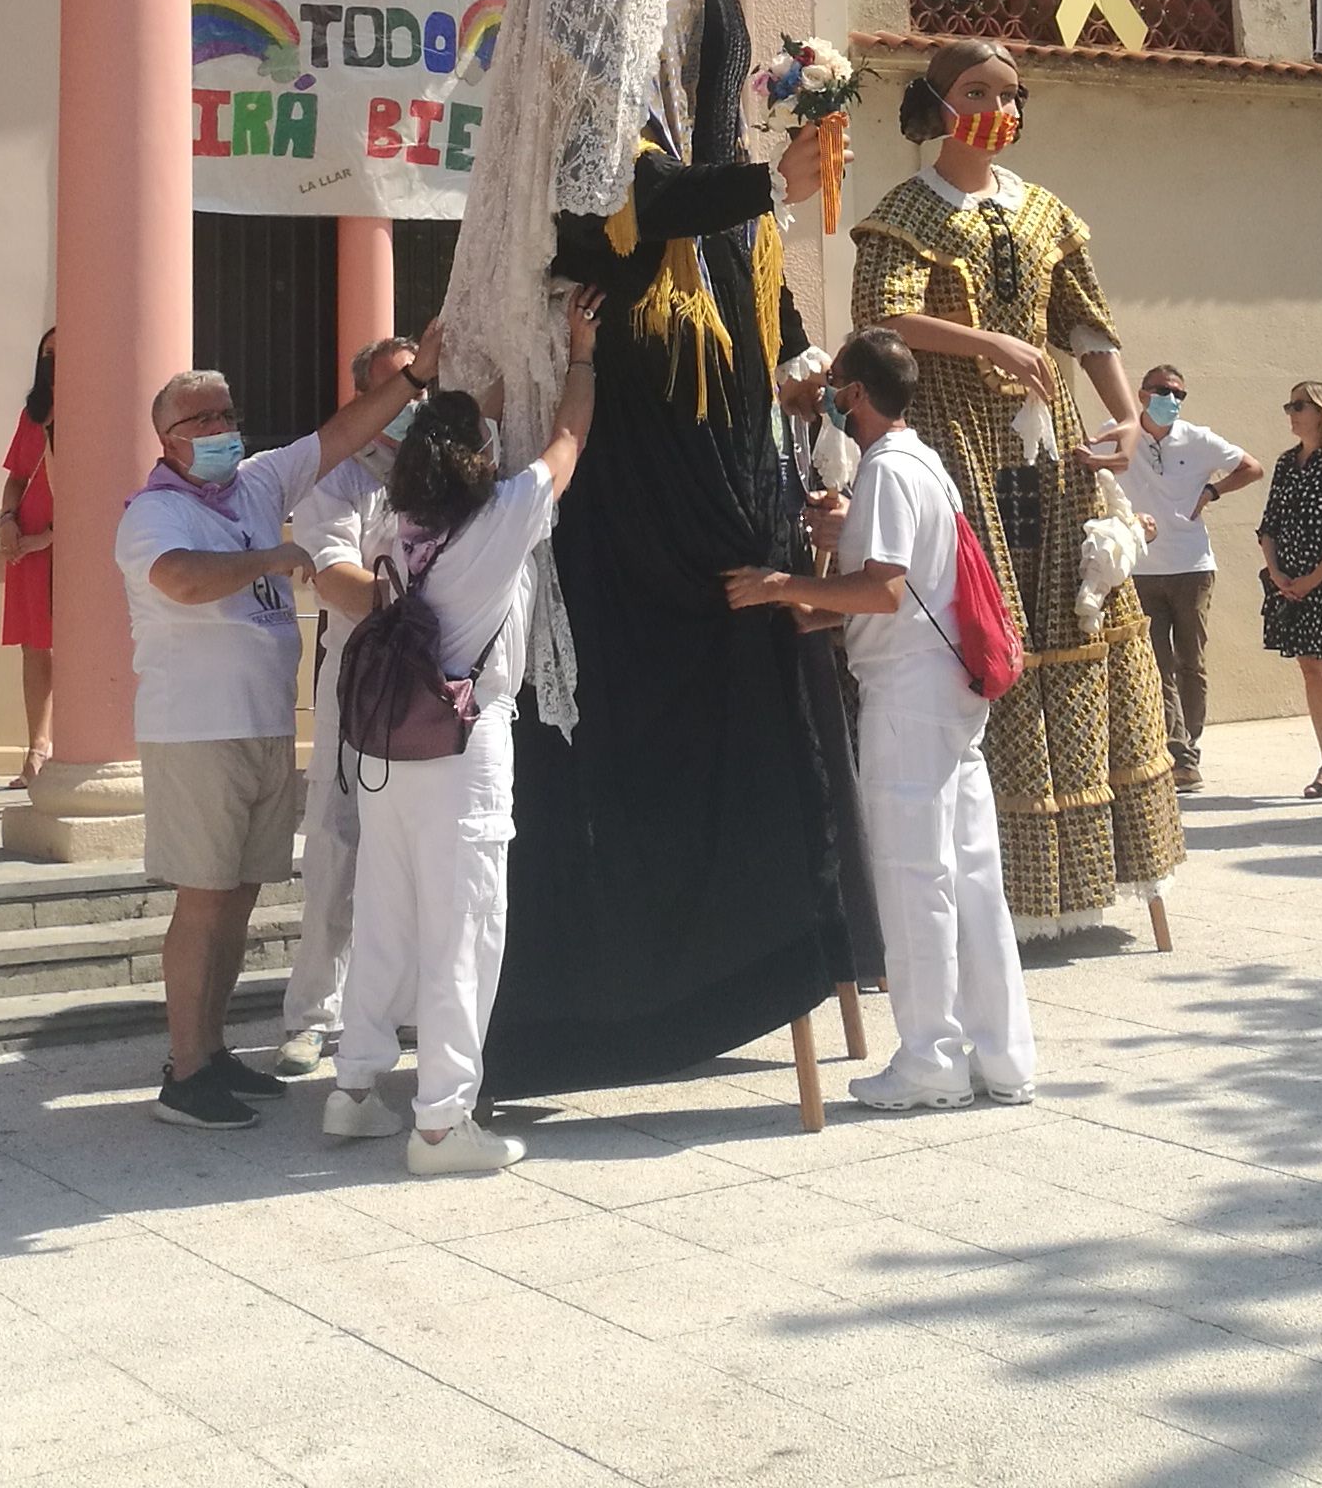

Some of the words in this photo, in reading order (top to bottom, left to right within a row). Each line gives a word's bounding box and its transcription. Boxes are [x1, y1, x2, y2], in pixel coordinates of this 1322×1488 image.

[299, 3, 457, 74] TODO
[191, 73, 318, 159] IRÁ
[299, 179, 318, 194] LA
[319, 168, 353, 188] LLAR
